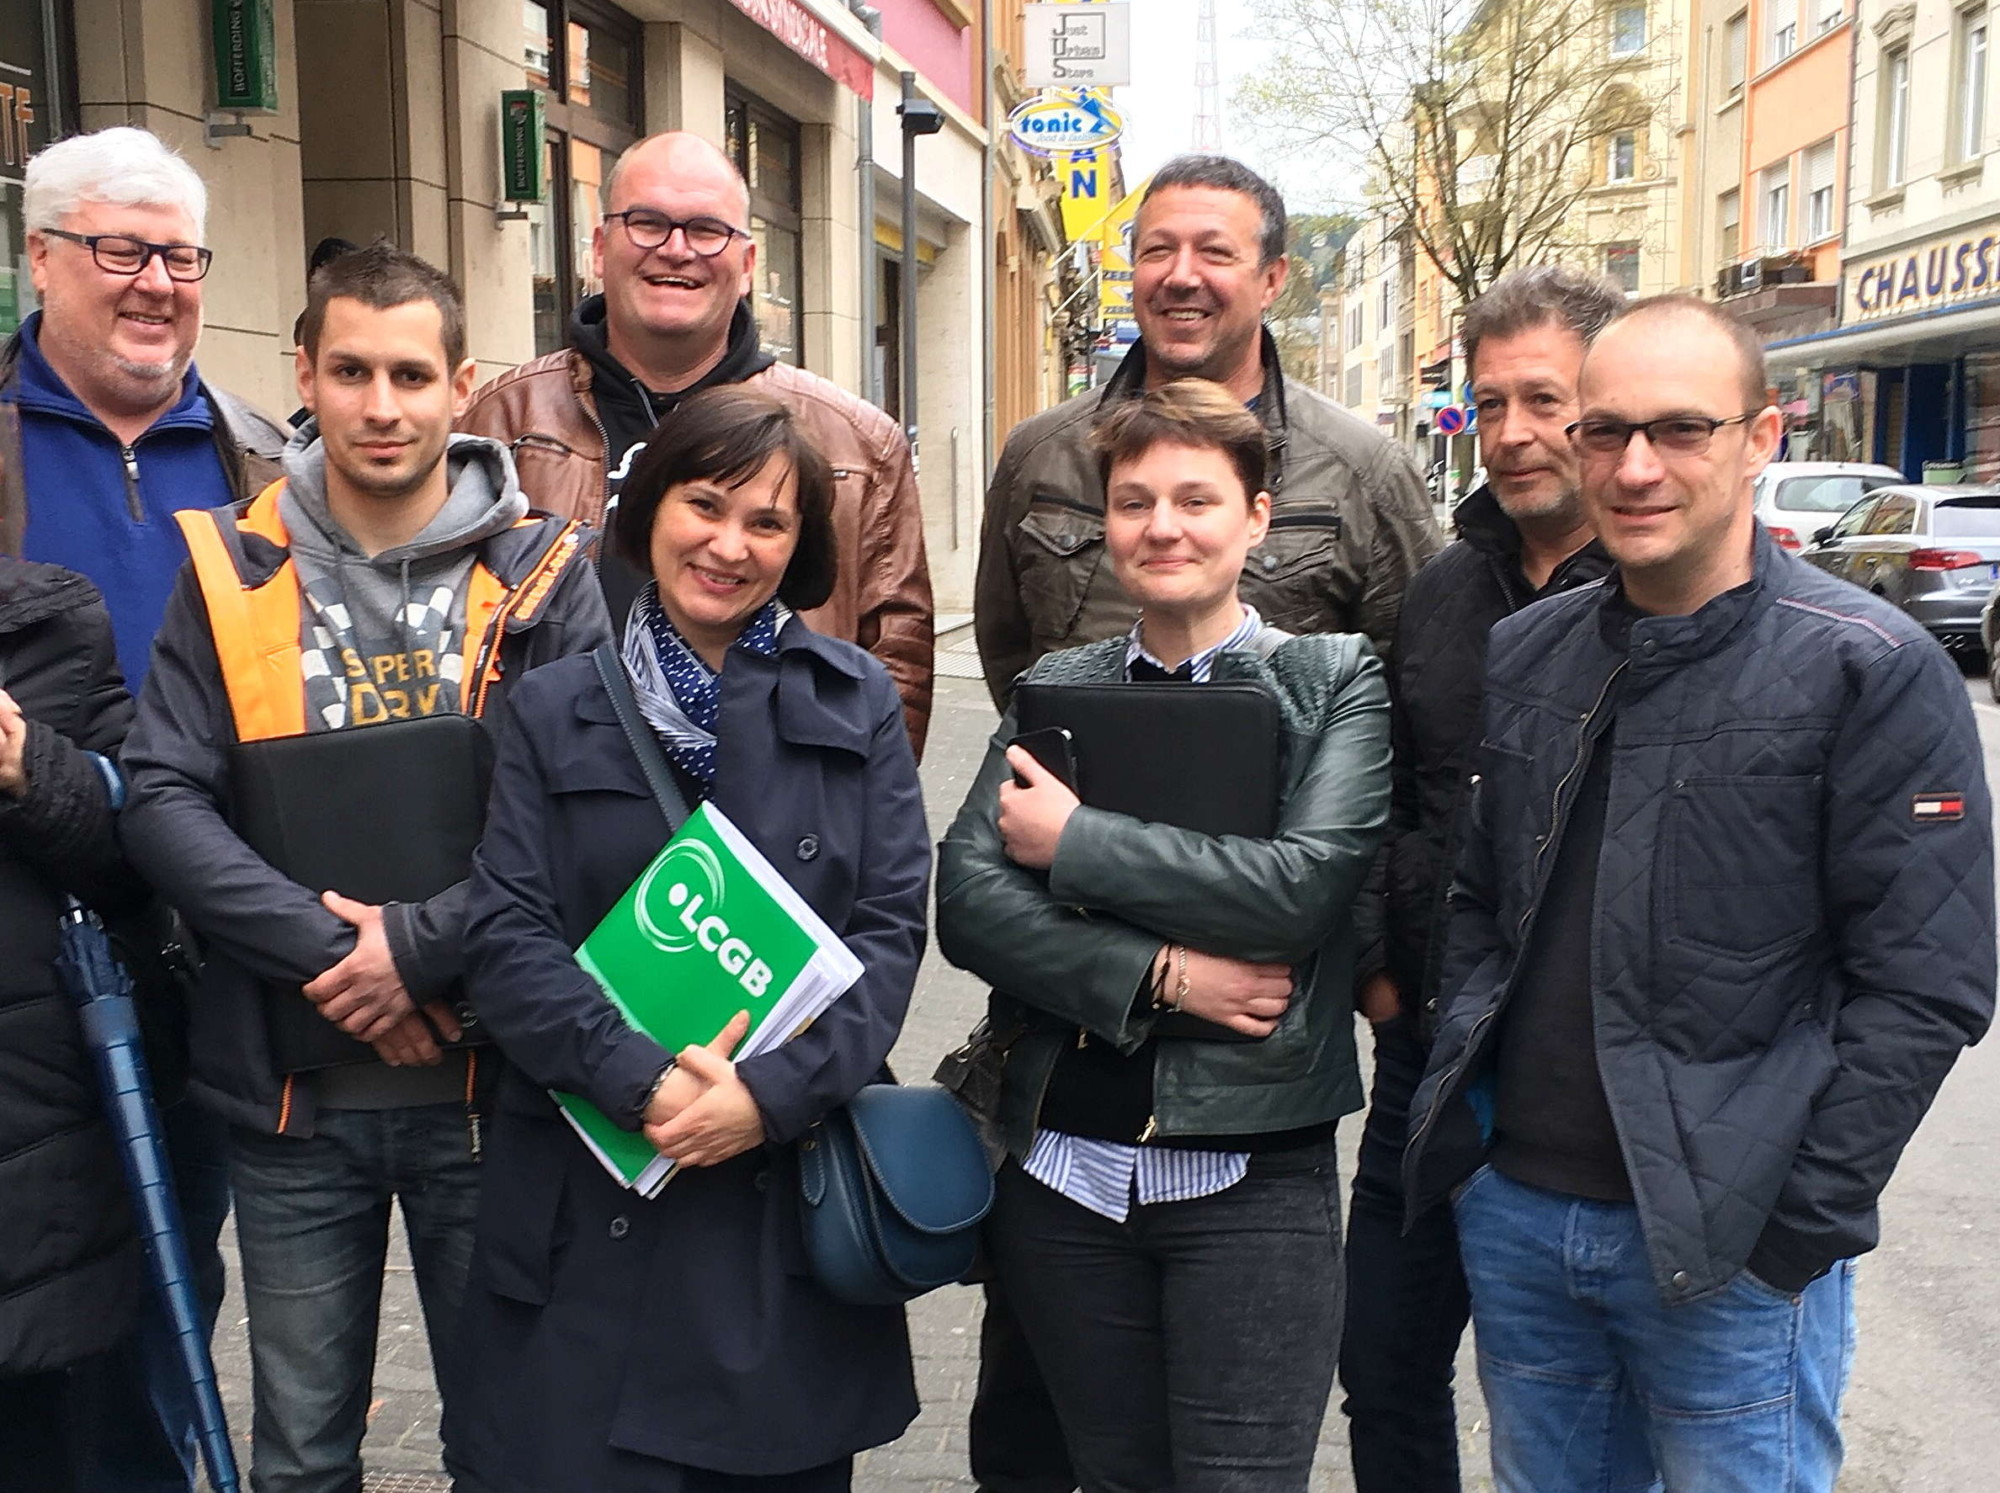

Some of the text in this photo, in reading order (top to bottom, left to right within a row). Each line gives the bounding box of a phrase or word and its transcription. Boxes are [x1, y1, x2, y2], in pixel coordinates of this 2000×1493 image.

[1052, 13, 1089, 37] Just
[1052, 58, 1094, 79] Store
[1020, 112, 1083, 133] tonic
[1857, 236, 2000, 310] CHAUSS
[341, 648, 437, 684] SPER
[679, 893, 774, 998] LCGB
